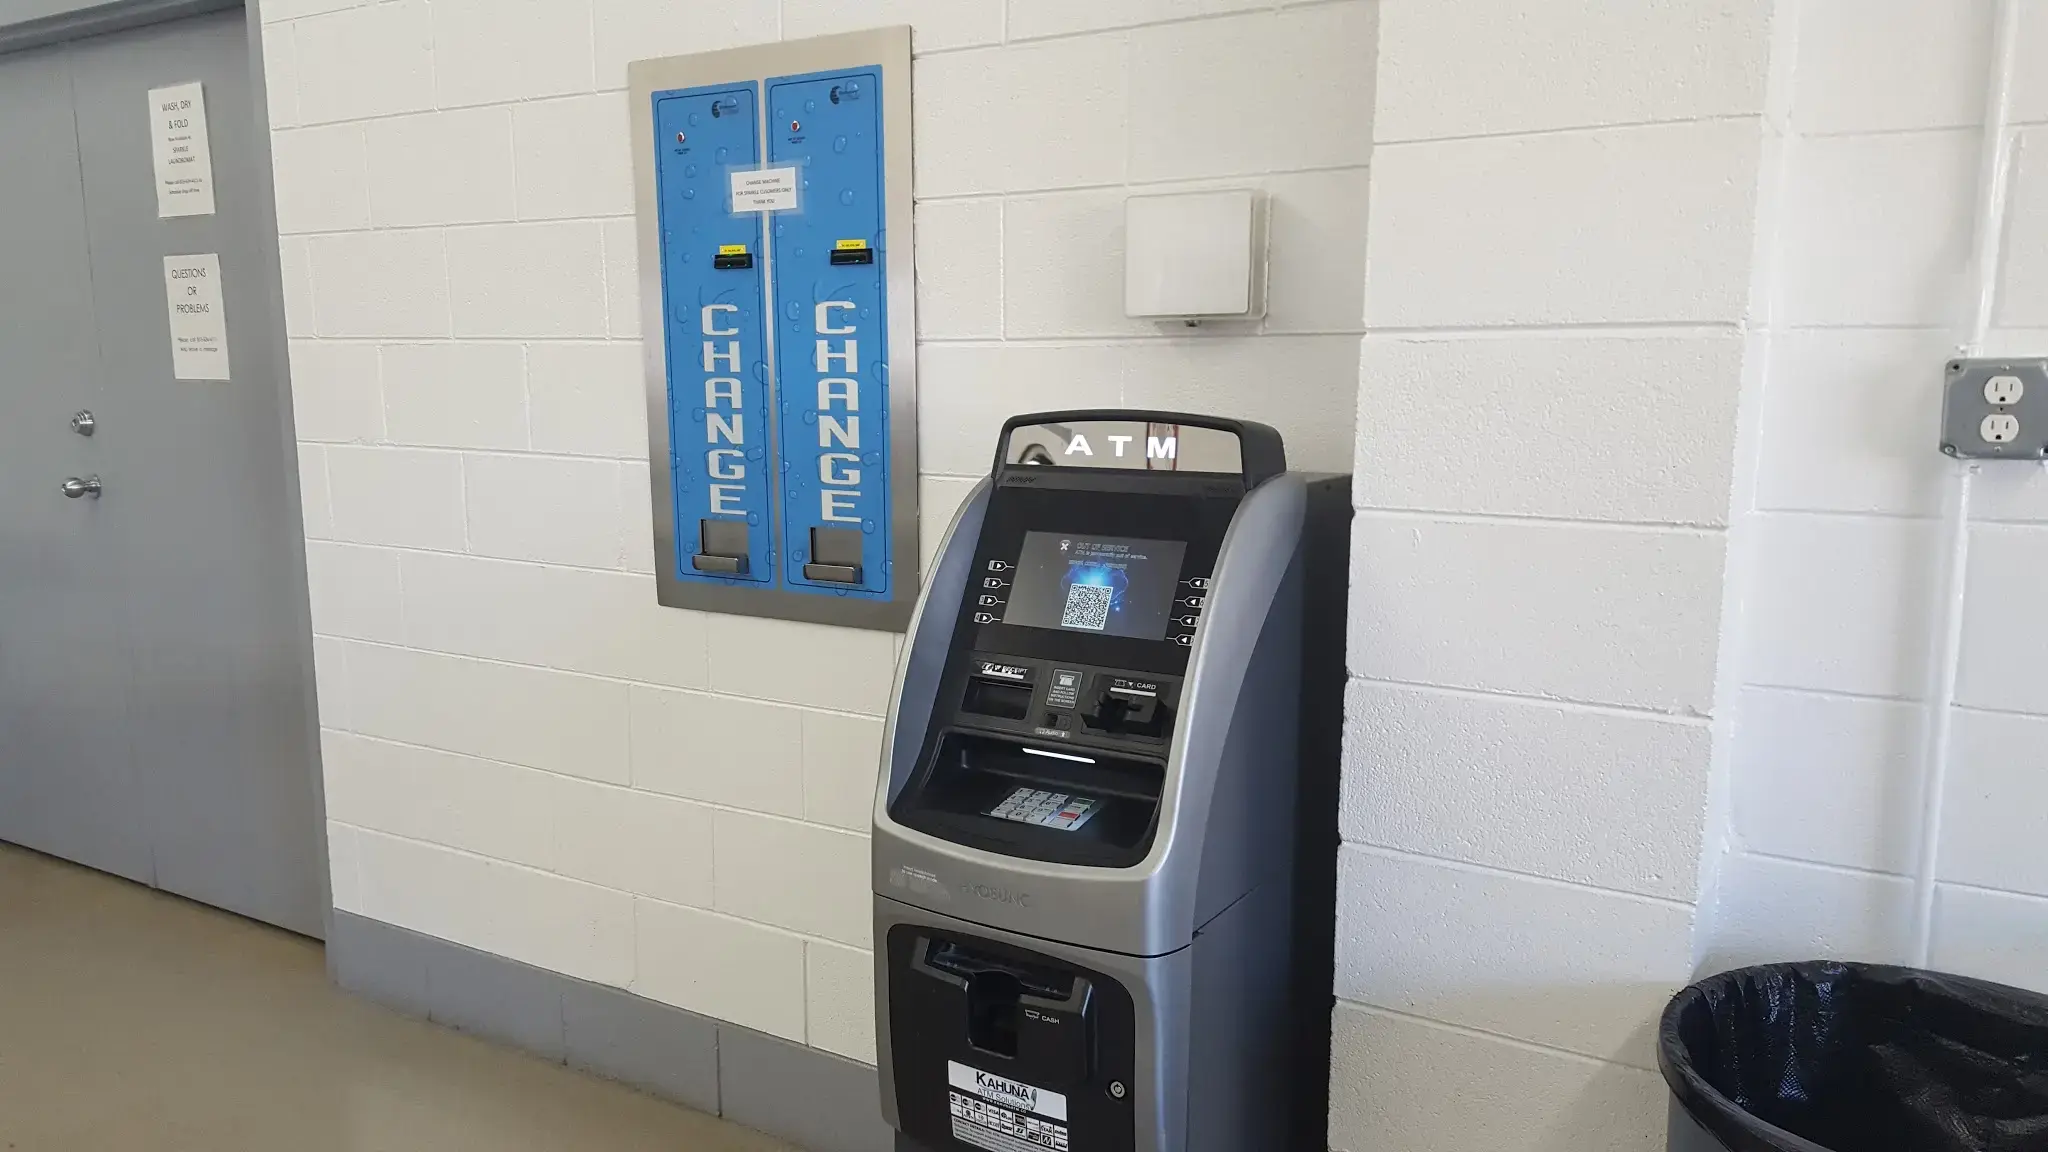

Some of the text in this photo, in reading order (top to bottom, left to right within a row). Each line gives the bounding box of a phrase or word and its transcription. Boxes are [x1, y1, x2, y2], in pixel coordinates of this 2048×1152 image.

[162, 100, 192, 112] WASH, DRY
[168, 119, 188, 130] & FOLD
[172, 268, 206, 279] QUESTIONS
[187, 286, 197, 295] OR
[176, 304, 209, 314] PROBLEMS
[701, 303, 748, 516] CHANGE
[815, 300, 862, 523] CHANGE
[1065, 434, 1176, 459] ATM
[1102, 544, 1130, 552] SERVICE
[1041, 1015, 1060, 1024] CASH
[976, 1071, 1030, 1100] KAHUNA
[978, 1088, 1030, 1110] ATM Solutions
